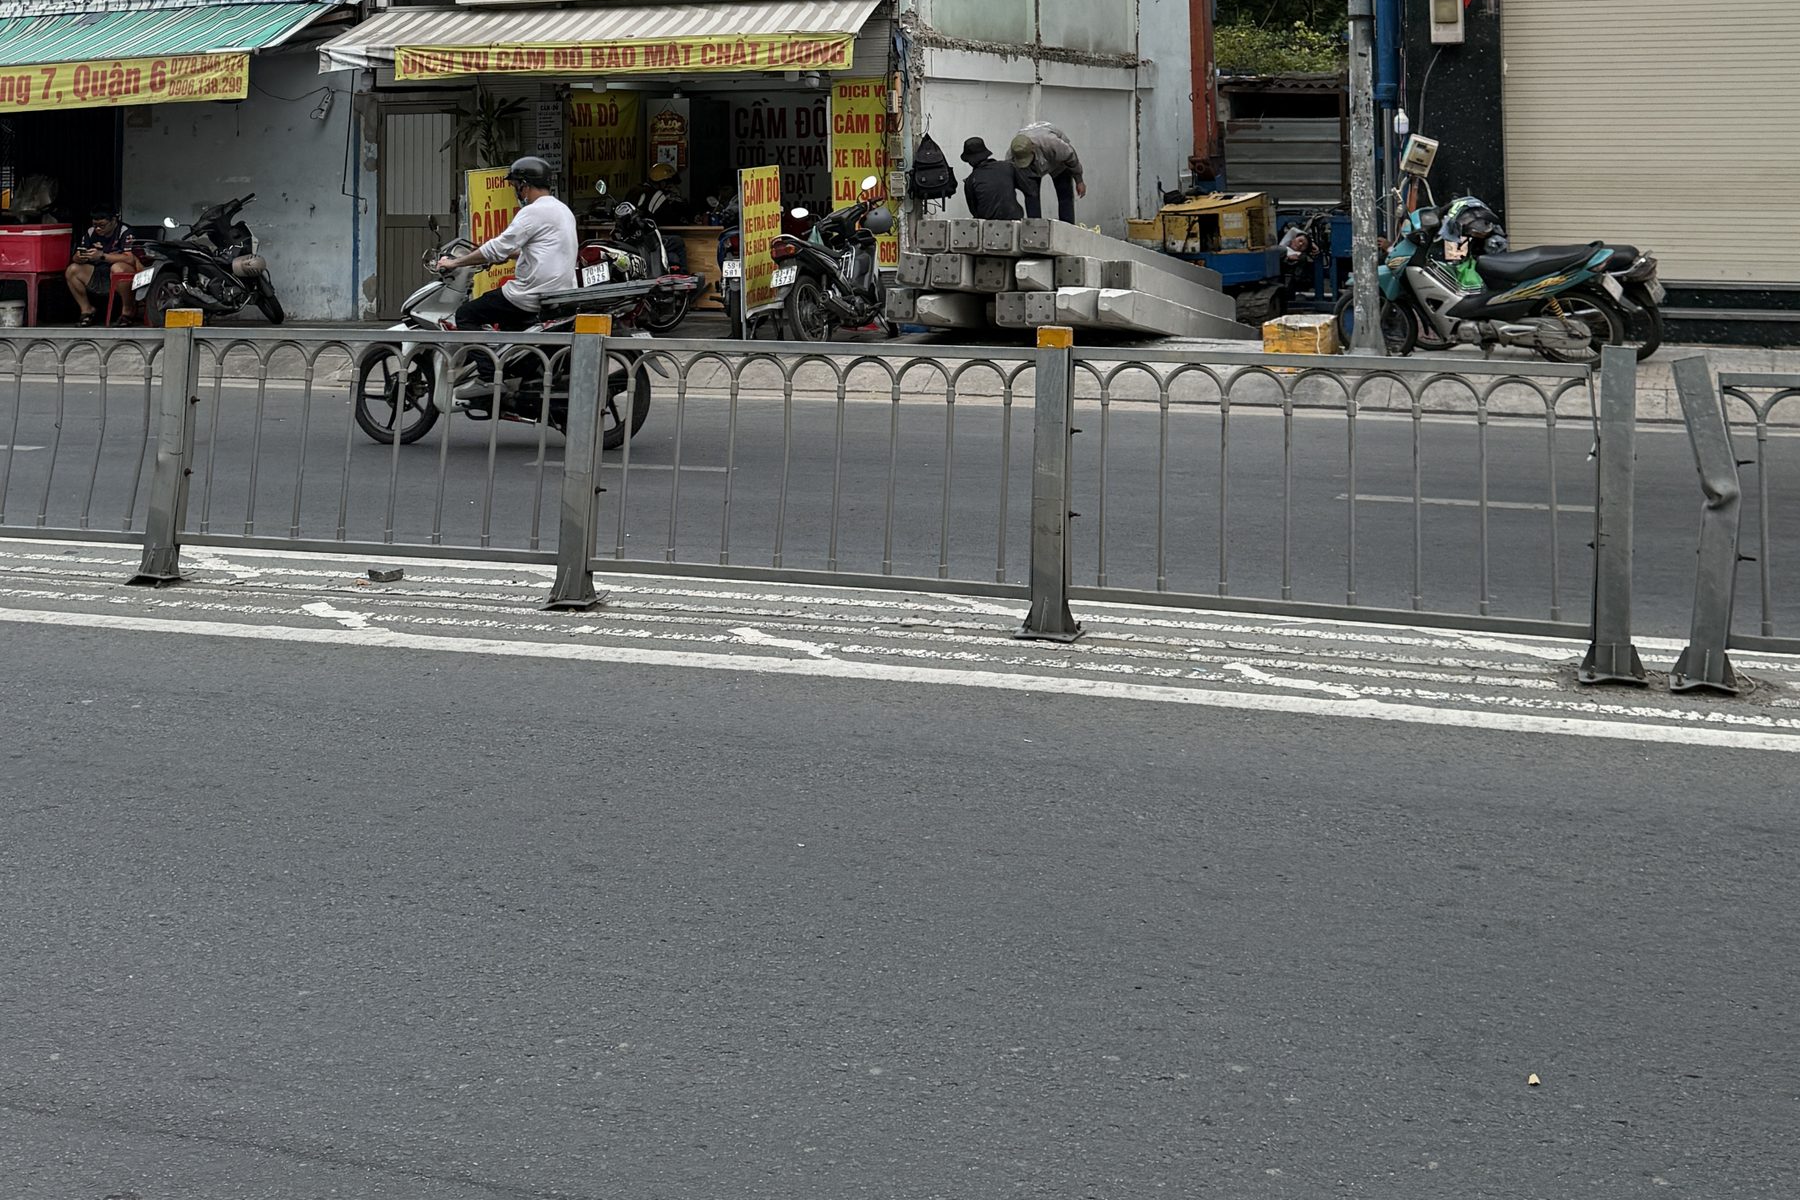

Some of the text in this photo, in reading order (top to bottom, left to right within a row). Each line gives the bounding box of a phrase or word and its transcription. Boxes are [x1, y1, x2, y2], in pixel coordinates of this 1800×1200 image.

[644, 41, 693, 70] MẬT
[701, 36, 760, 65] CHẤT
[767, 41, 846, 68] LƯỢNG
[40, 68, 63, 103] 7,
[72, 62, 141, 103] Quận
[150, 60, 167, 93] 6
[839, 84, 870, 100] DỊCH
[734, 98, 787, 139] CẦM
[834, 107, 870, 134] CẦM
[835, 149, 848, 168] XE
[851, 143, 872, 168] TRẢ
[485, 176, 505, 192] DỊCH
[834, 176, 856, 201] LÃI
[472, 196, 508, 245] CẦM
[745, 218, 753, 234] XE
[880, 241, 898, 263] 603
